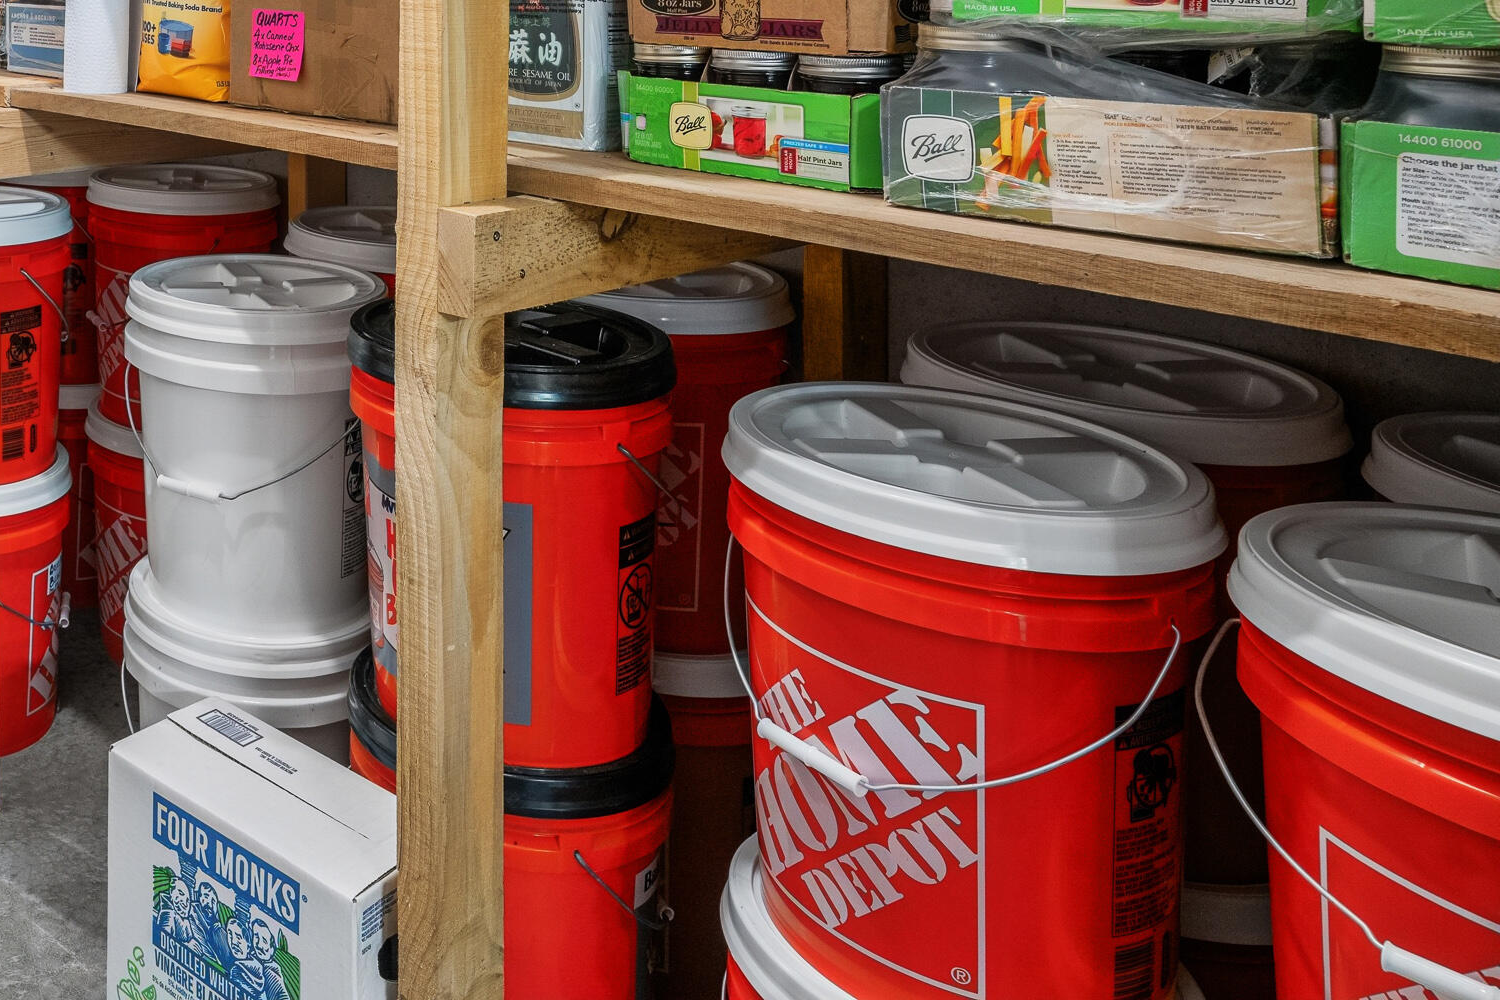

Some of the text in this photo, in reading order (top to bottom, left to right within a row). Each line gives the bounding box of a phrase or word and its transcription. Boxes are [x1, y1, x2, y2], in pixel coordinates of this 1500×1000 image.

[152, 0, 223, 14] Trusted Baking Soda Brand
[964, 4, 986, 12] MADE
[1001, 5, 1017, 13] USA
[256, 11, 299, 28] QUARTS
[658, 17, 818, 38] JELLY JARS
[266, 30, 295, 41] Canned
[1397, 28, 1430, 36] MADE
[1450, 30, 1474, 38] USA
[263, 54, 281, 69] Apple
[522, 69, 571, 81] SESAME OIL
[675, 115, 704, 136] Ball
[911, 134, 966, 164] Ball
[1399, 134, 1482, 150] 14400 61000
[798, 155, 842, 166] Half Pint Jars
[1402, 155, 1498, 173] Choose the jar that
[761, 668, 825, 750] THE
[756, 687, 978, 878] HOME
[157, 801, 297, 924] FOUR MONKS
[801, 806, 979, 929] DEPOT
[154, 948, 194, 993] VINAGRE
[160, 932, 240, 999] DISTILLED WHITE
